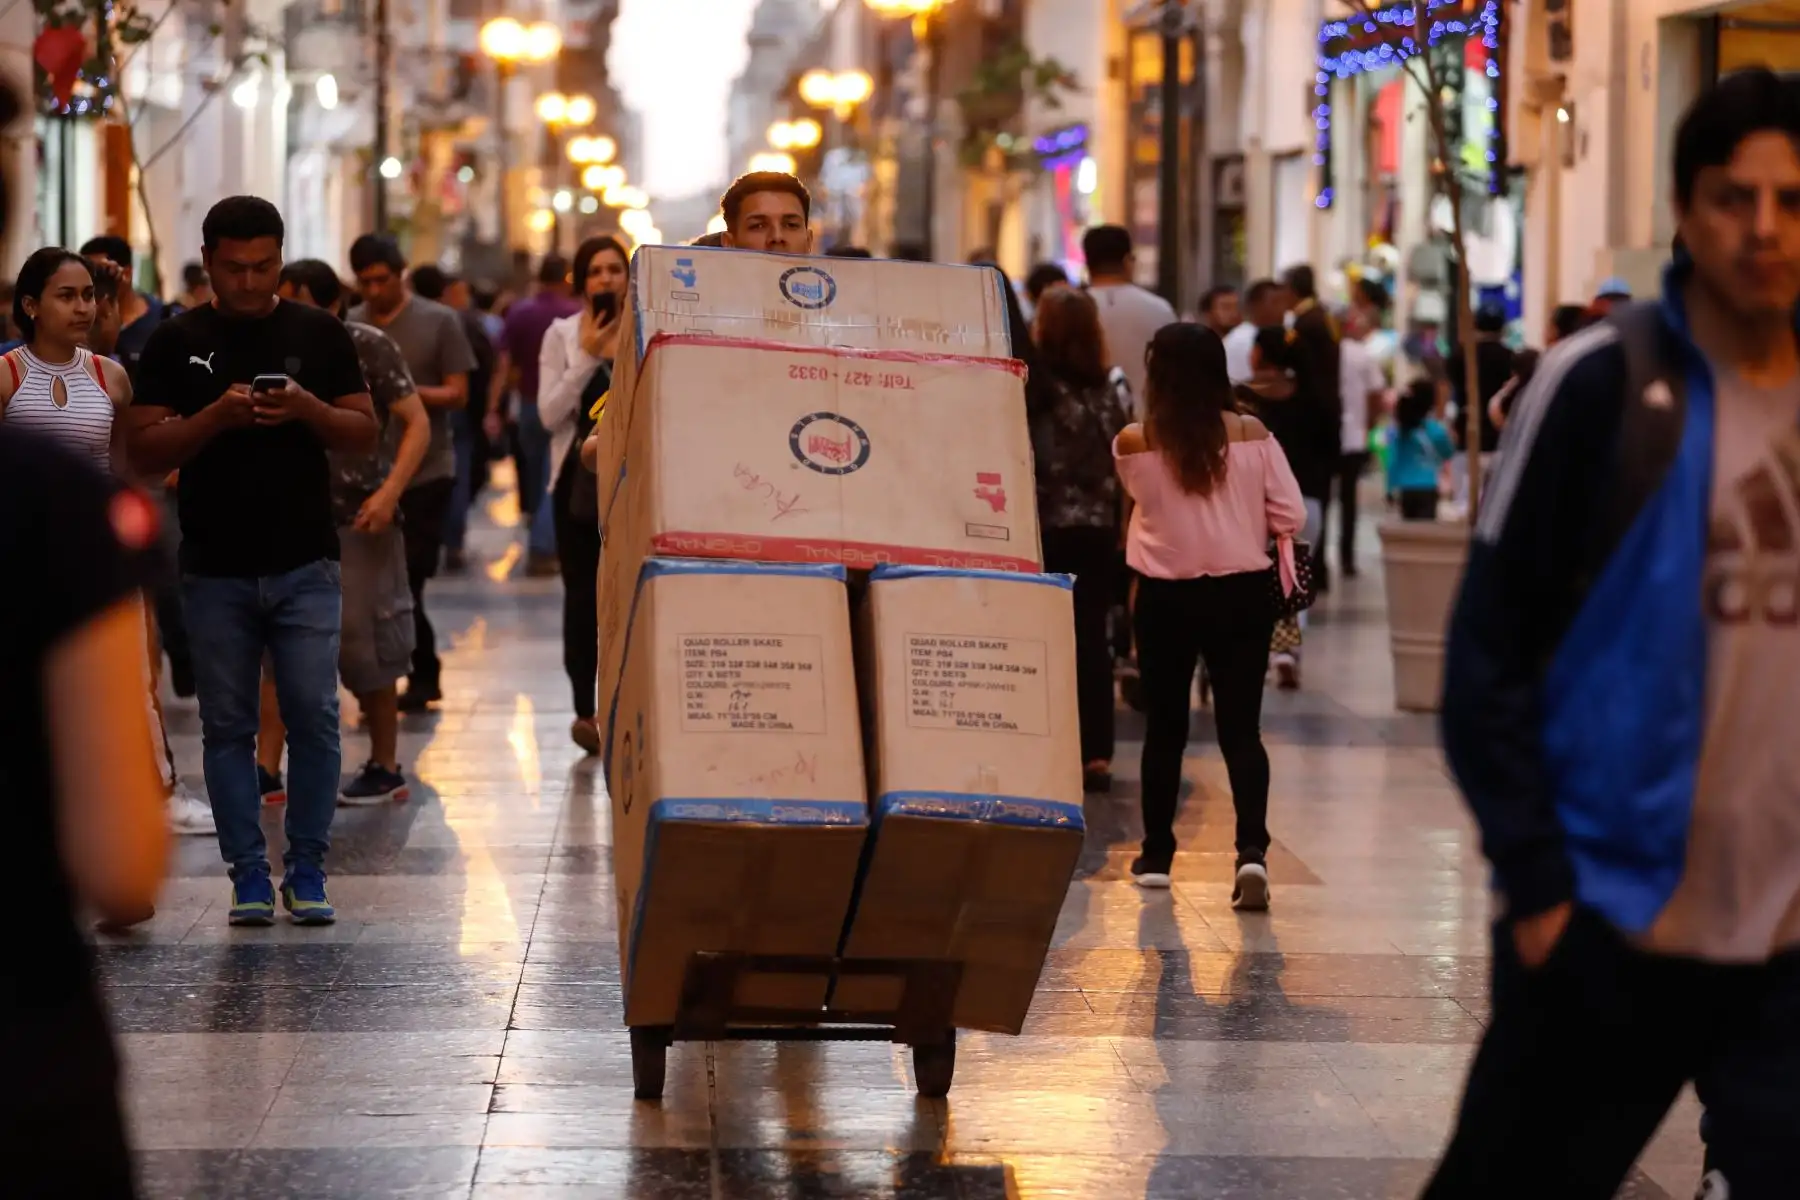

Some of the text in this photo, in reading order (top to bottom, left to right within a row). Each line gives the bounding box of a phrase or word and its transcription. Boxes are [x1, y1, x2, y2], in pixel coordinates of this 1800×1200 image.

[788, 365, 828, 381] 0332
[844, 371, 872, 387] 427
[684, 638, 783, 647] QUAD ROLLER SKATE
[910, 638, 1008, 650] QUAD ROLLER SKATE
[988, 712, 1002, 720] CM
[768, 721, 793, 729] CHINA
[956, 719, 980, 727] MADE
[993, 721, 1018, 729] CHINA
